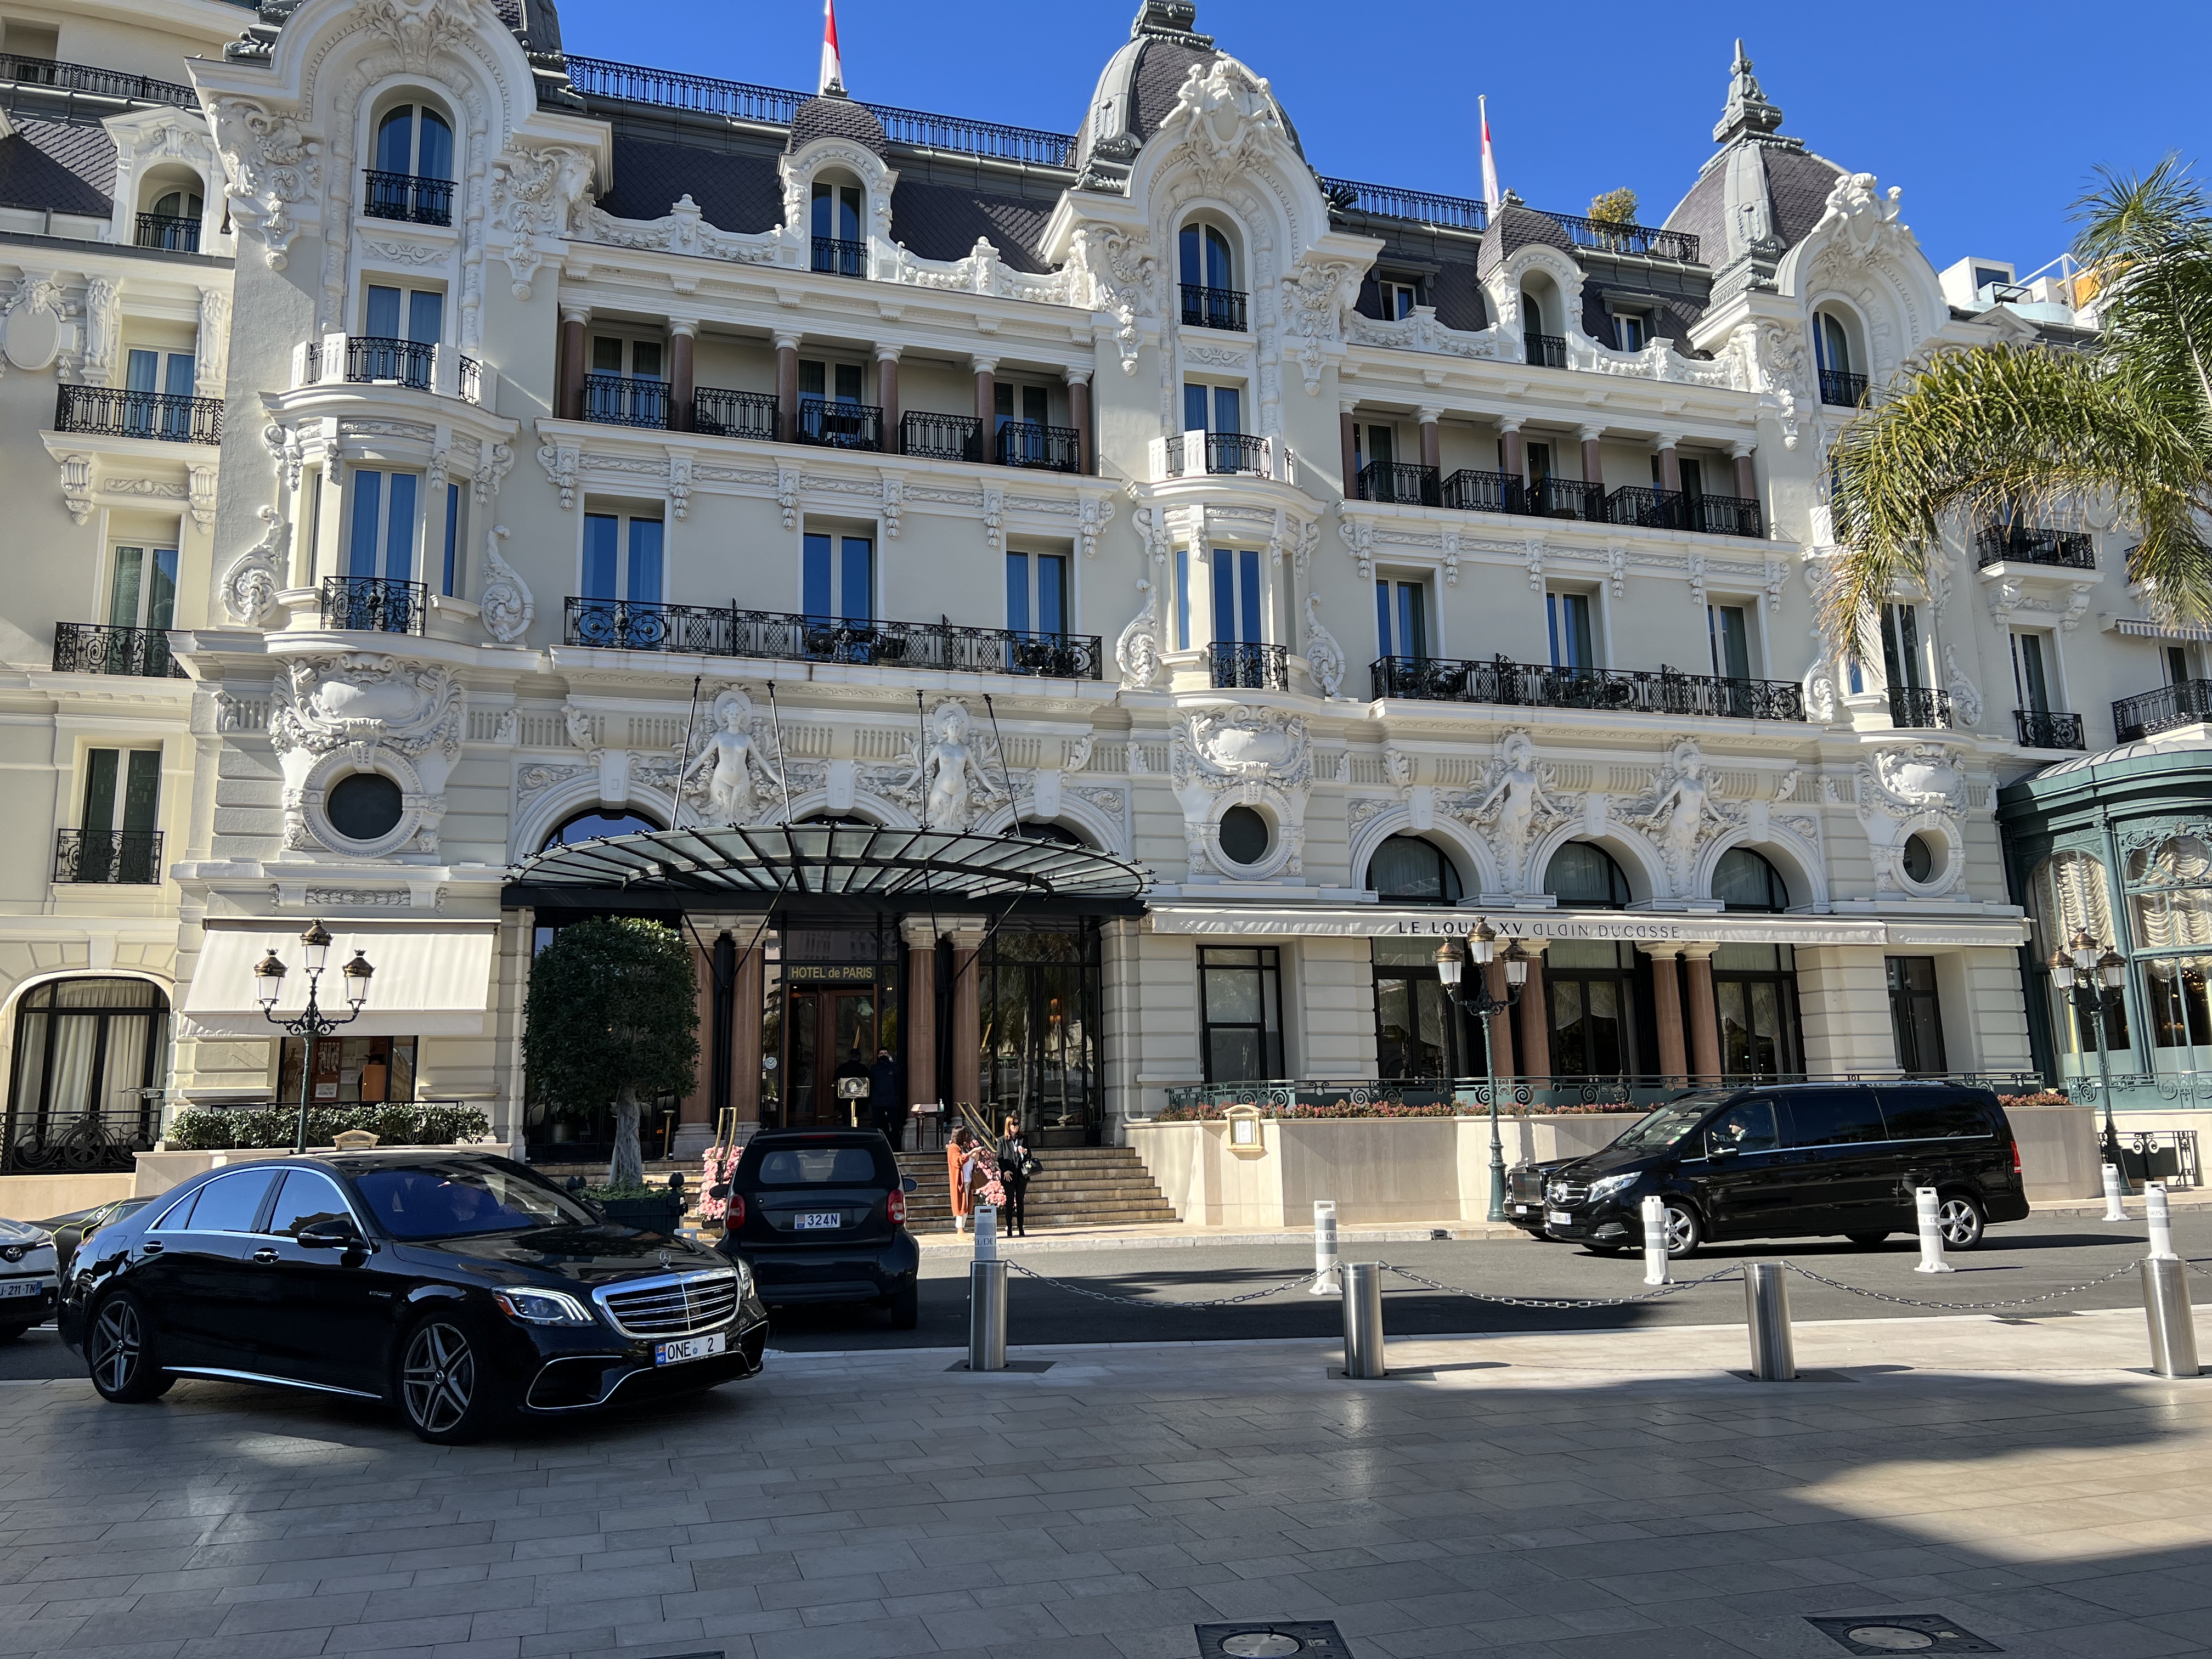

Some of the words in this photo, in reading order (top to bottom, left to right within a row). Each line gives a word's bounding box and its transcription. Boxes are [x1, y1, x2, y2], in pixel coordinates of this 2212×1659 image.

[1399, 921, 1420, 933] LE
[1499, 923, 1523, 935] XV
[791, 967, 826, 978] HOTEL
[828, 967, 840, 978] de
[843, 967, 872, 978] PARIS
[808, 1214, 838, 1226] 324N
[668, 1341, 691, 1360] ONE
[707, 1337, 714, 1353] 2
